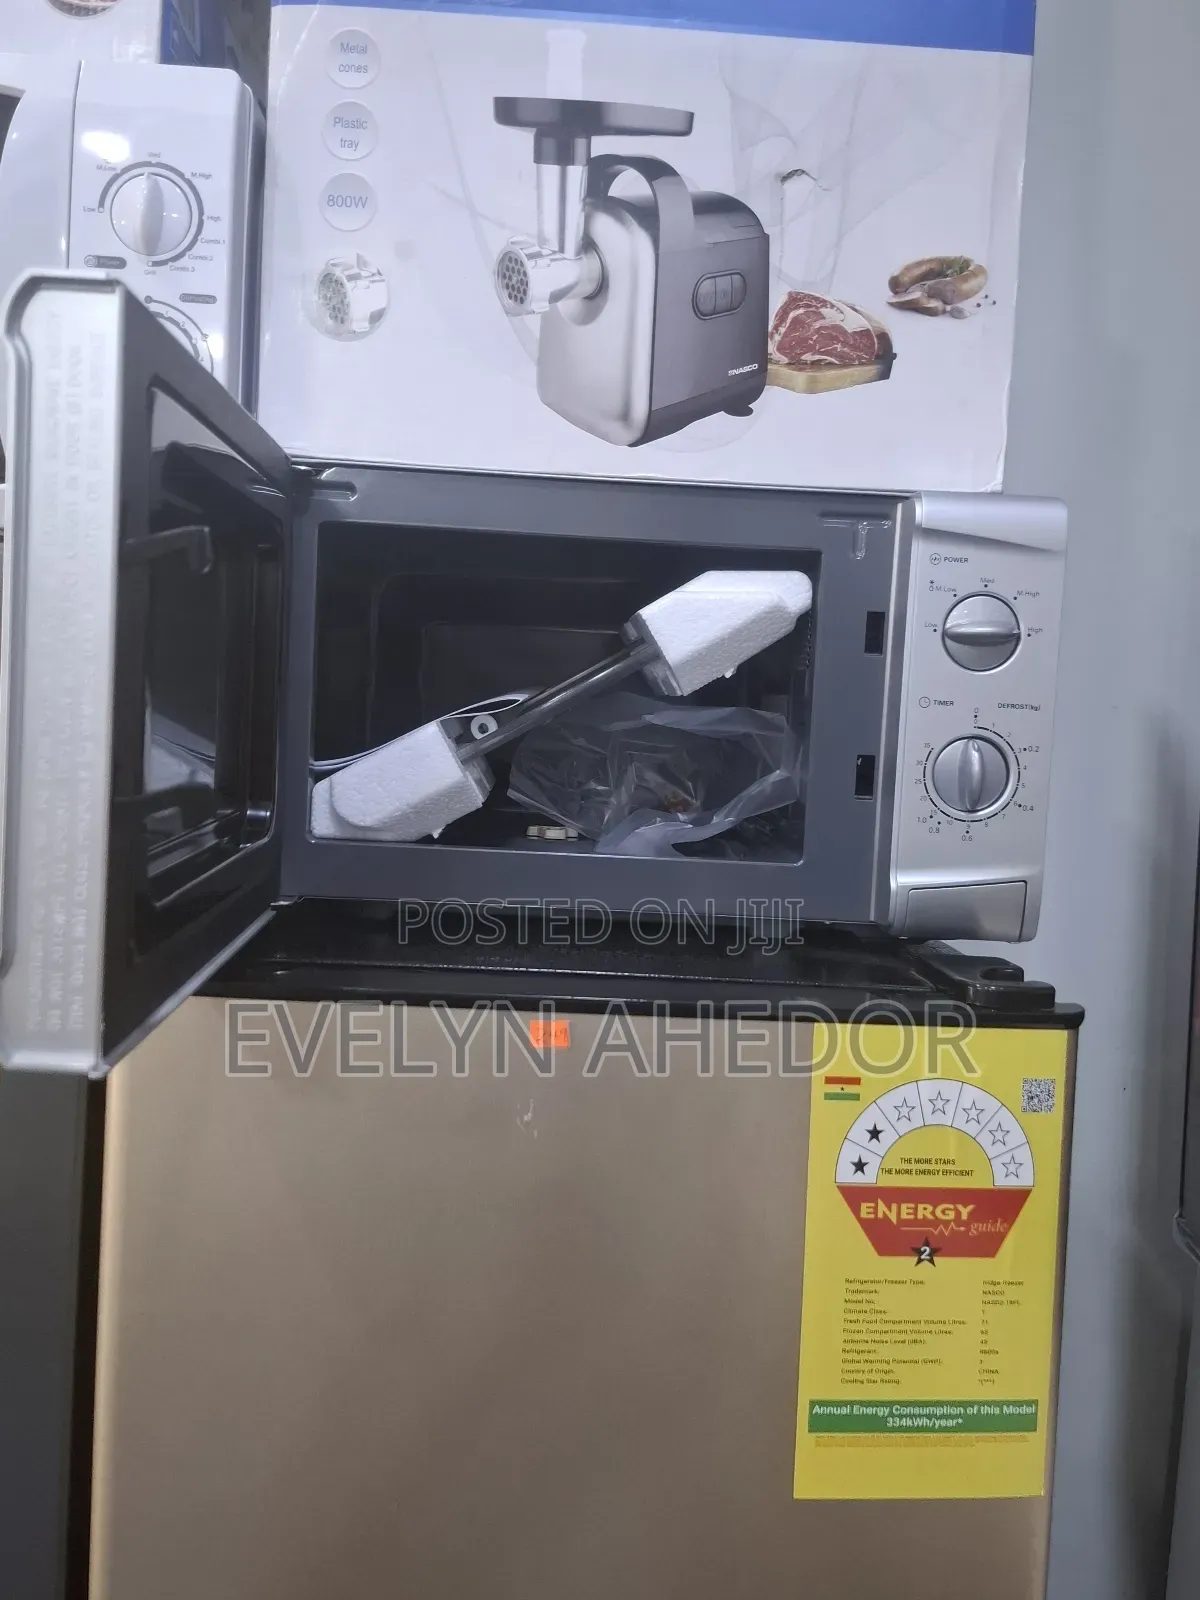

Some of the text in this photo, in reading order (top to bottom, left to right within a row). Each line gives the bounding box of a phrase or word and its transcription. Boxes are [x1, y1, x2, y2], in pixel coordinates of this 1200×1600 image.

[340, 42, 367, 55] Metal
[338, 63, 368, 74] cones
[333, 116, 367, 130] Plastic
[340, 137, 359, 151] tray
[326, 194, 368, 209] 800W
[943, 556, 969, 564] POWER
[900, 1157, 956, 1166] THE MORE STARS
[894, 1168, 914, 1176] MORE
[915, 1168, 940, 1177] ENERGY
[941, 1169, 974, 1177] EFFICIENT
[859, 1198, 976, 1226] ENERGY
[969, 1218, 1007, 1236] guide
[920, 1246, 931, 1260] 2
[812, 1404, 1035, 1417] Annual Energy Consumption of this Model
